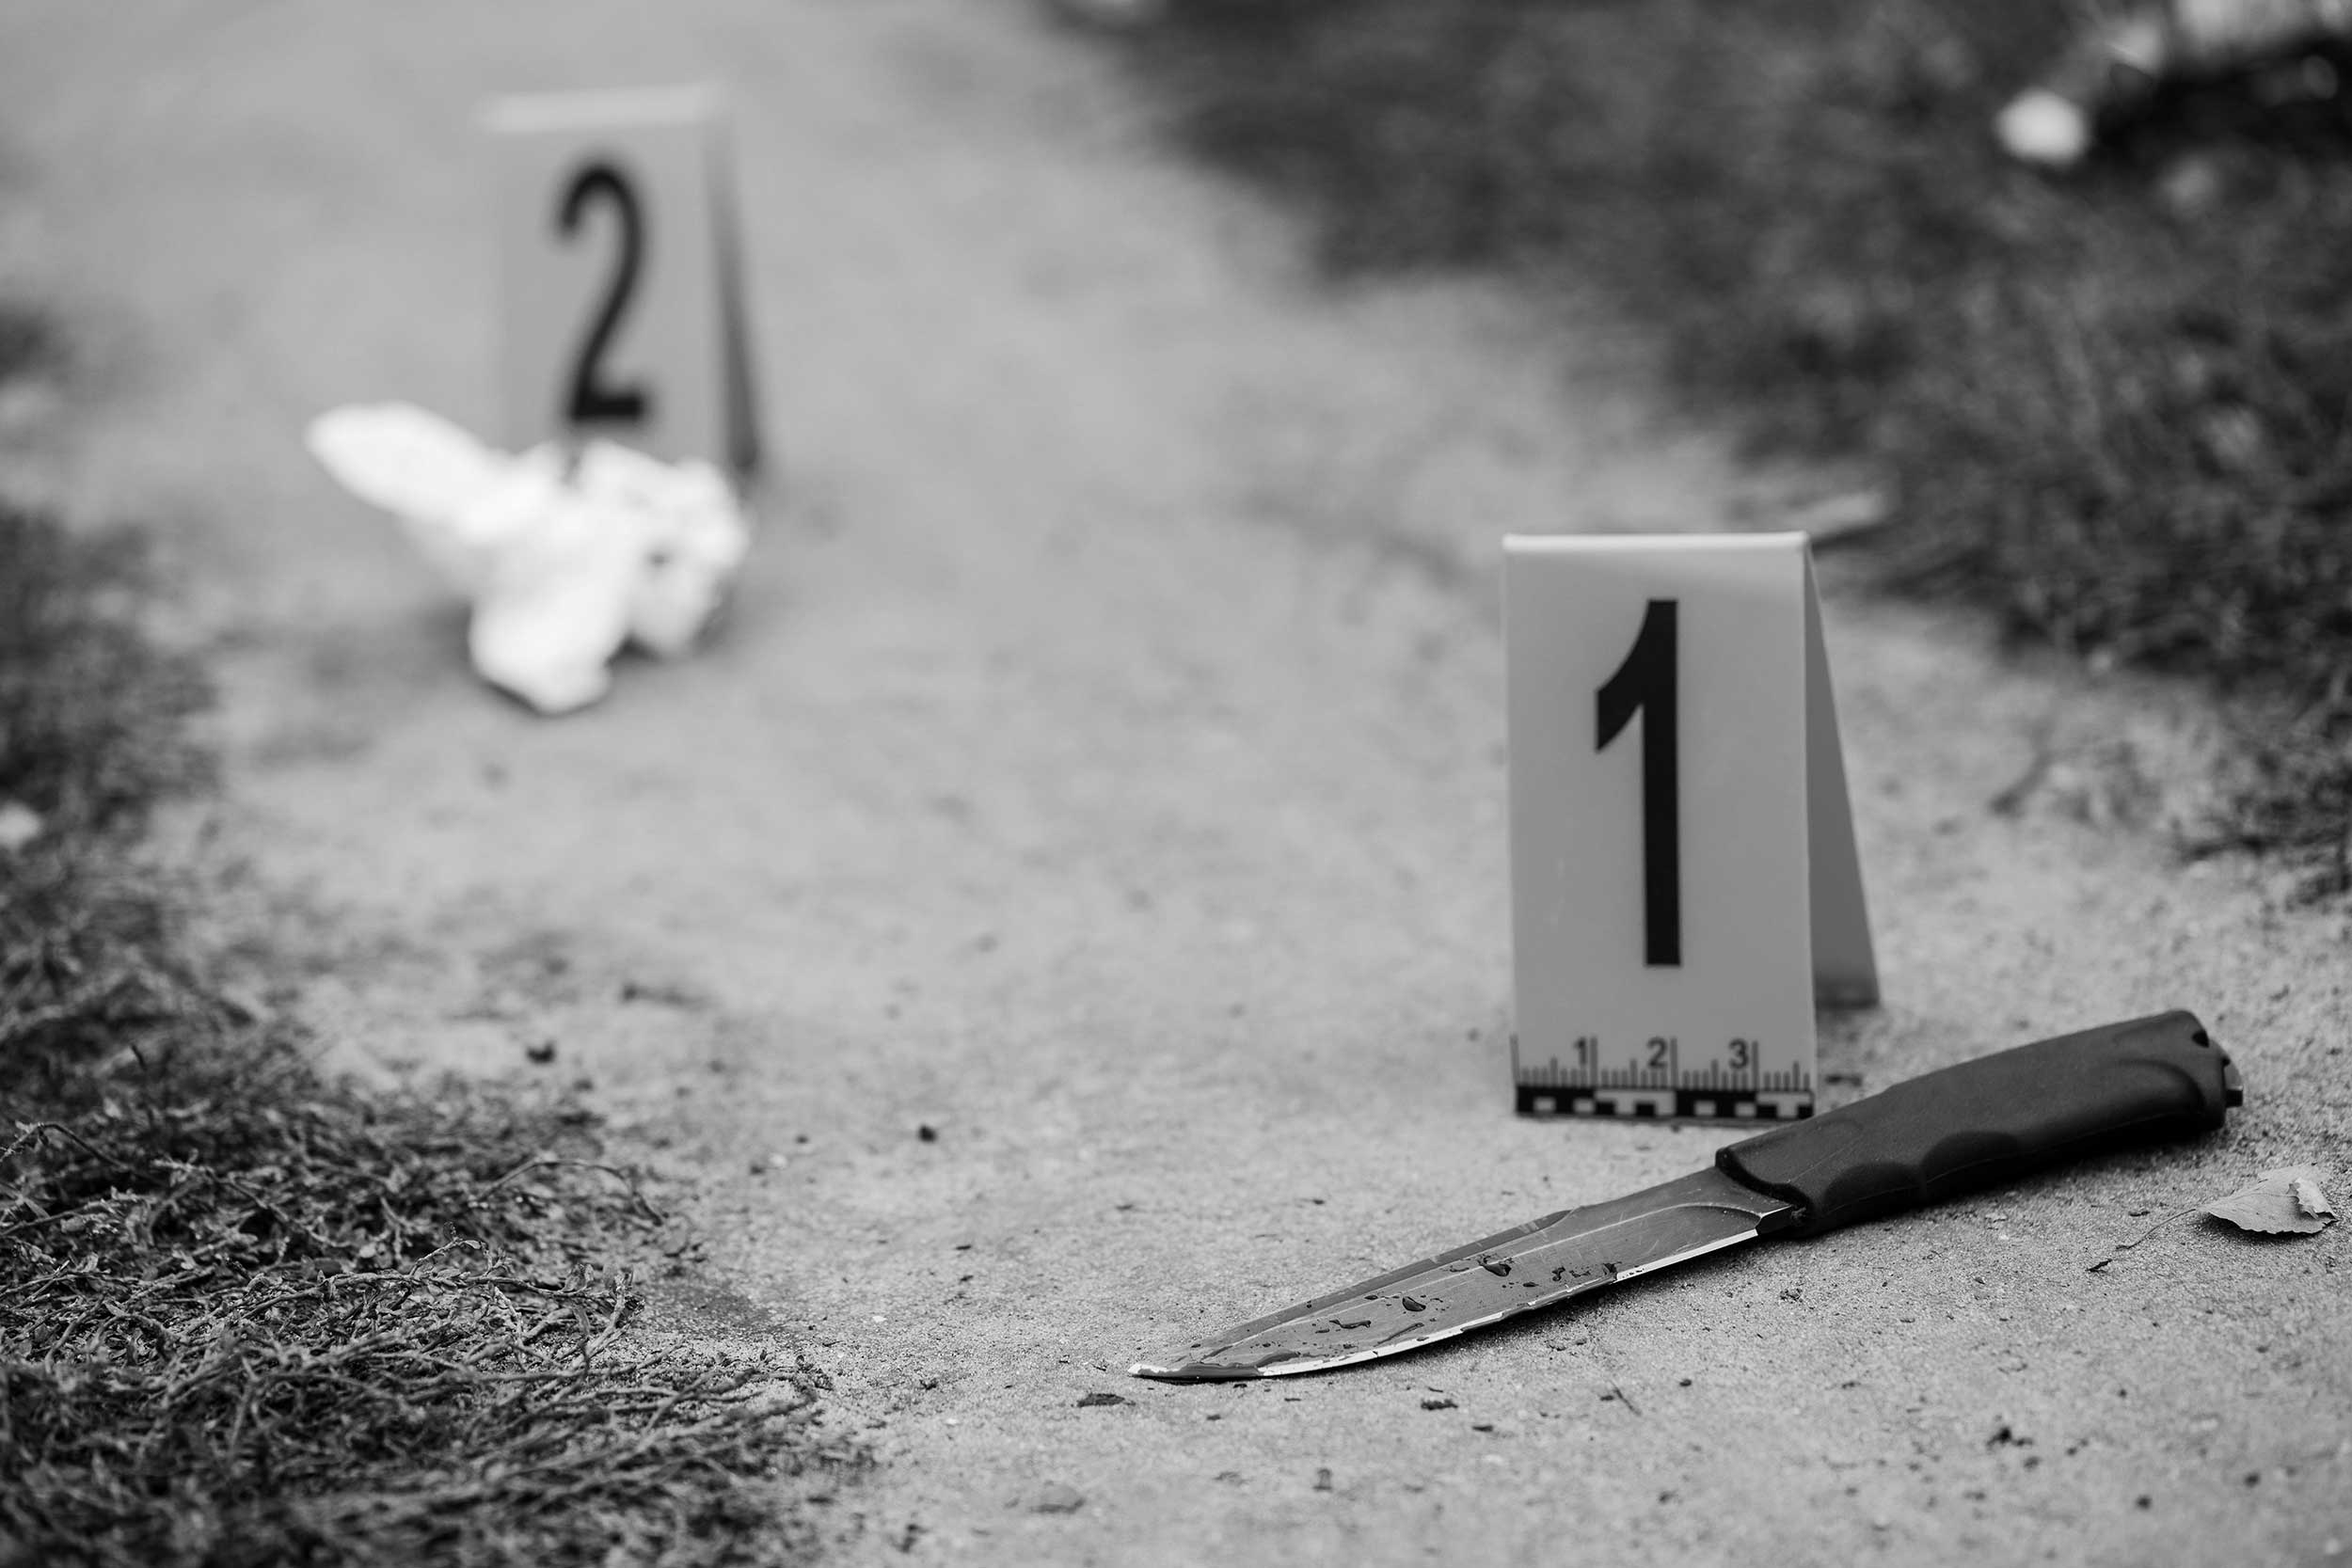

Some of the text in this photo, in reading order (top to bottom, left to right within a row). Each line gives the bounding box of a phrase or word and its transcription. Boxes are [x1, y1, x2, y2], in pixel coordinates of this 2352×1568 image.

[553, 155, 651, 431] 2
[1596, 599, 1682, 968] 1
[1573, 1037, 1751, 1070] 1 2 3
